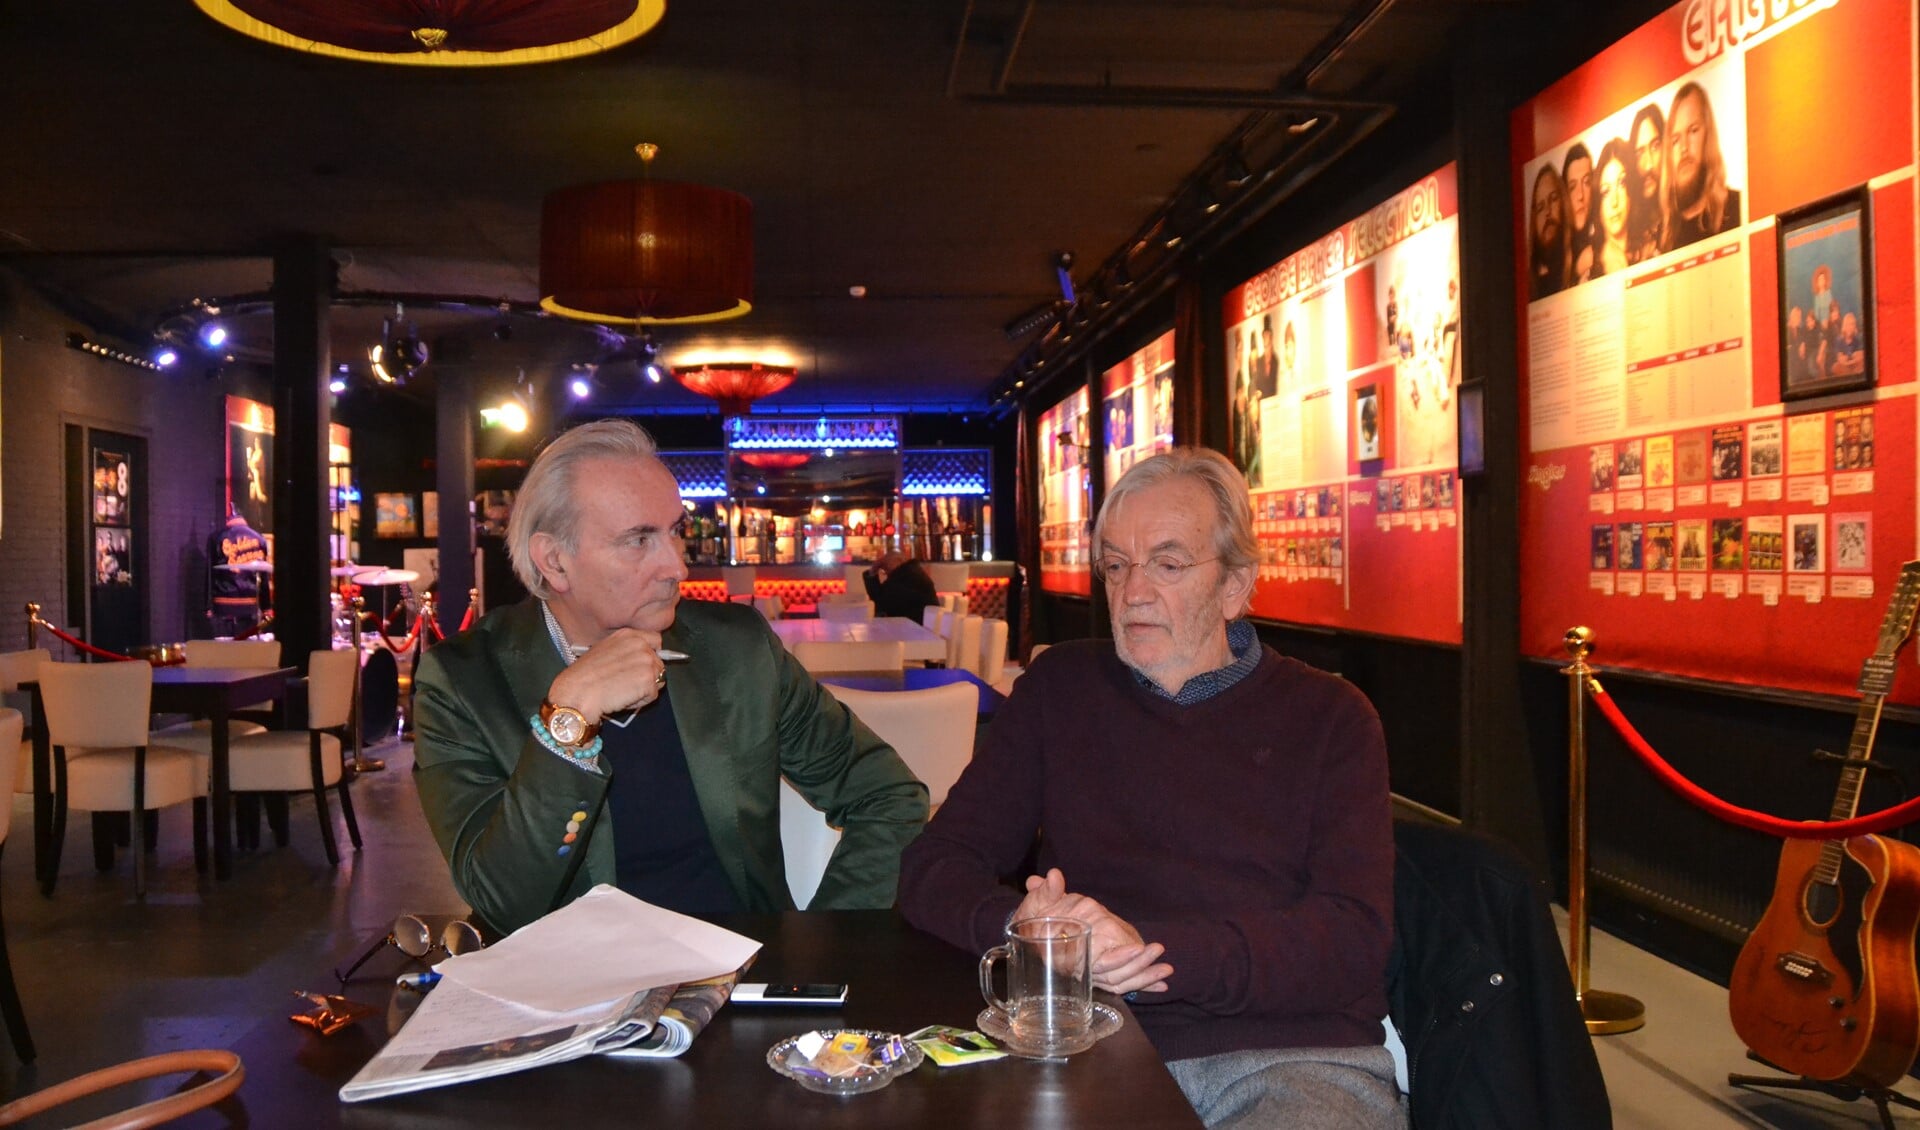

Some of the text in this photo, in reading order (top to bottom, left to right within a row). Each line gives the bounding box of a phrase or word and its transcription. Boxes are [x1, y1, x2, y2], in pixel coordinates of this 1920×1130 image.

[1244, 175, 1443, 317] GEORGE BAKER SELECTION
